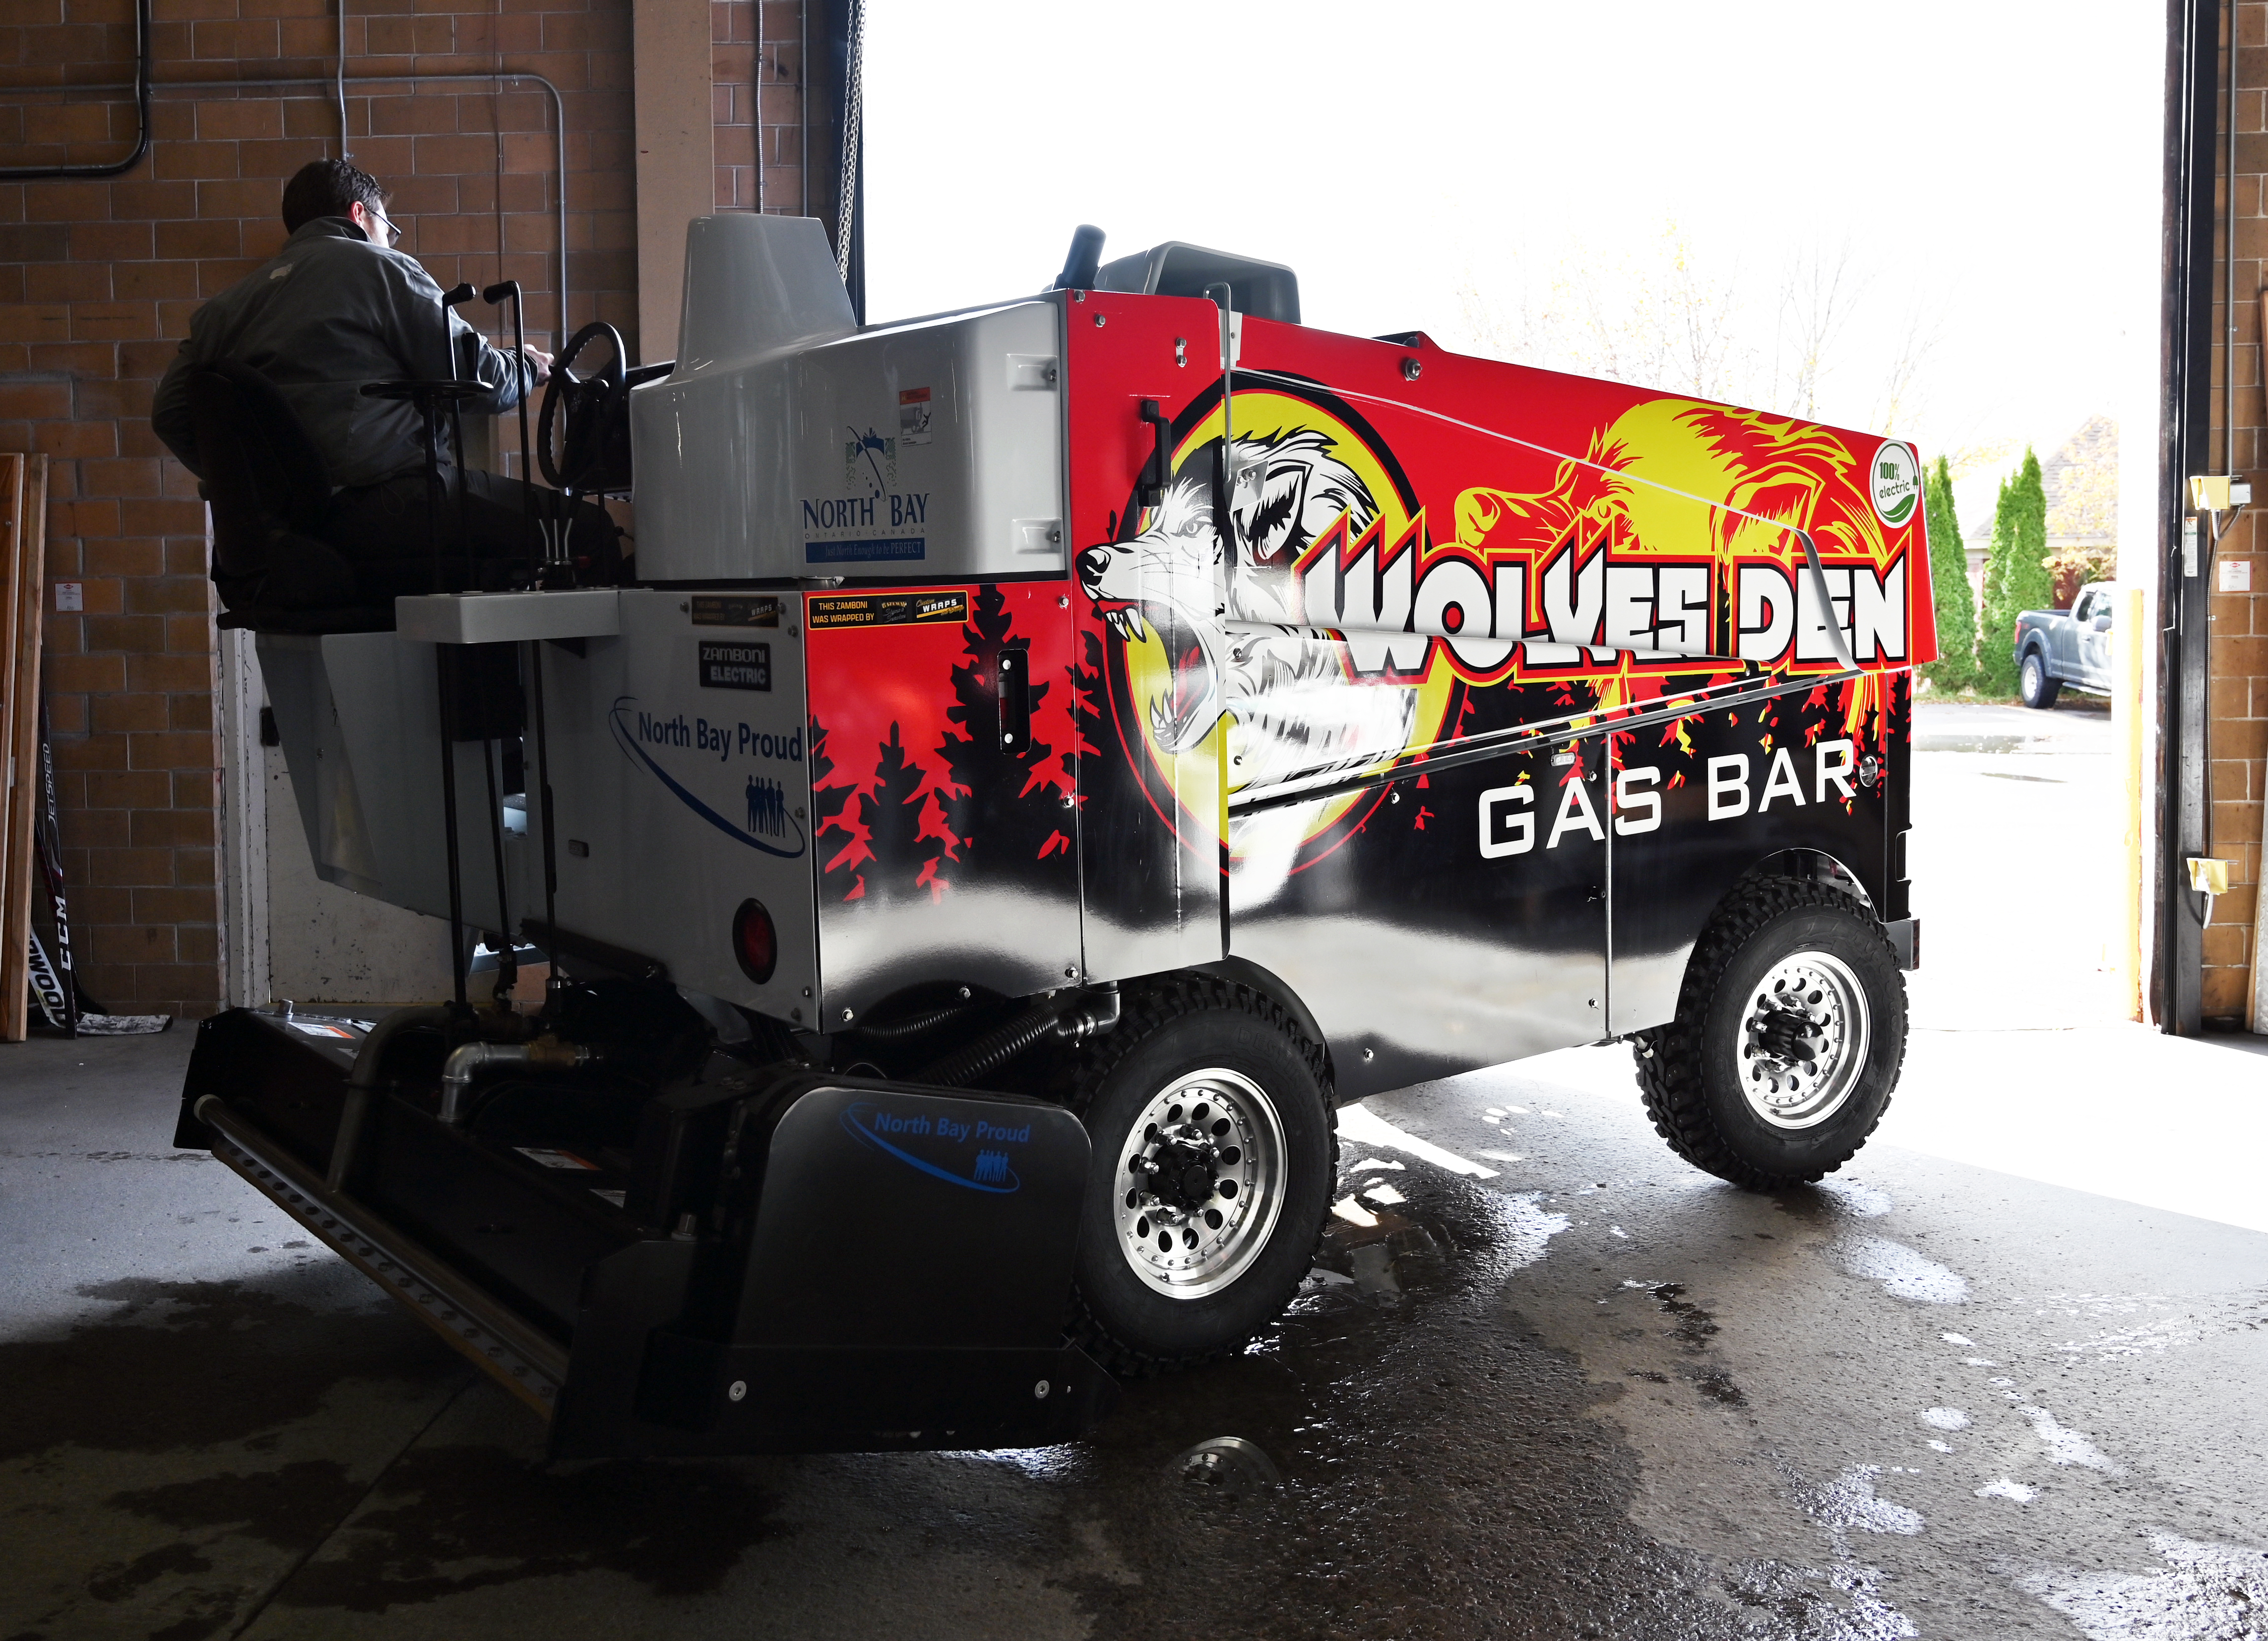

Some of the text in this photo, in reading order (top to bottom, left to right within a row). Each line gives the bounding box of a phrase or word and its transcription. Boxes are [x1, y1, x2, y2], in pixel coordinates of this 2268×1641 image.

[1880, 462, 1900, 481] 100%
[1879, 479, 1910, 499] electric
[800, 493, 929, 529] NORTH BAY
[805, 527, 925, 539] ONTARIO CANADA
[825, 541, 921, 558] Just North Enough to be PERFECT
[751, 604, 773, 616] WRAPS
[818, 600, 868, 611] THIS ZAMBONI
[922, 598, 957, 613] WRAPS
[1300, 537, 1907, 673] WOLVES DEN
[812, 612, 875, 624] WAS WRAPPED BY
[703, 647, 766, 664] ZAMBONI
[710, 665, 766, 684] ELECTRIC
[639, 712, 802, 762] North Bay Proud
[1478, 738, 1857, 859] GAS BAR
[55, 895, 72, 971] CCM
[874, 1112, 1031, 1143] North Bay Proud
